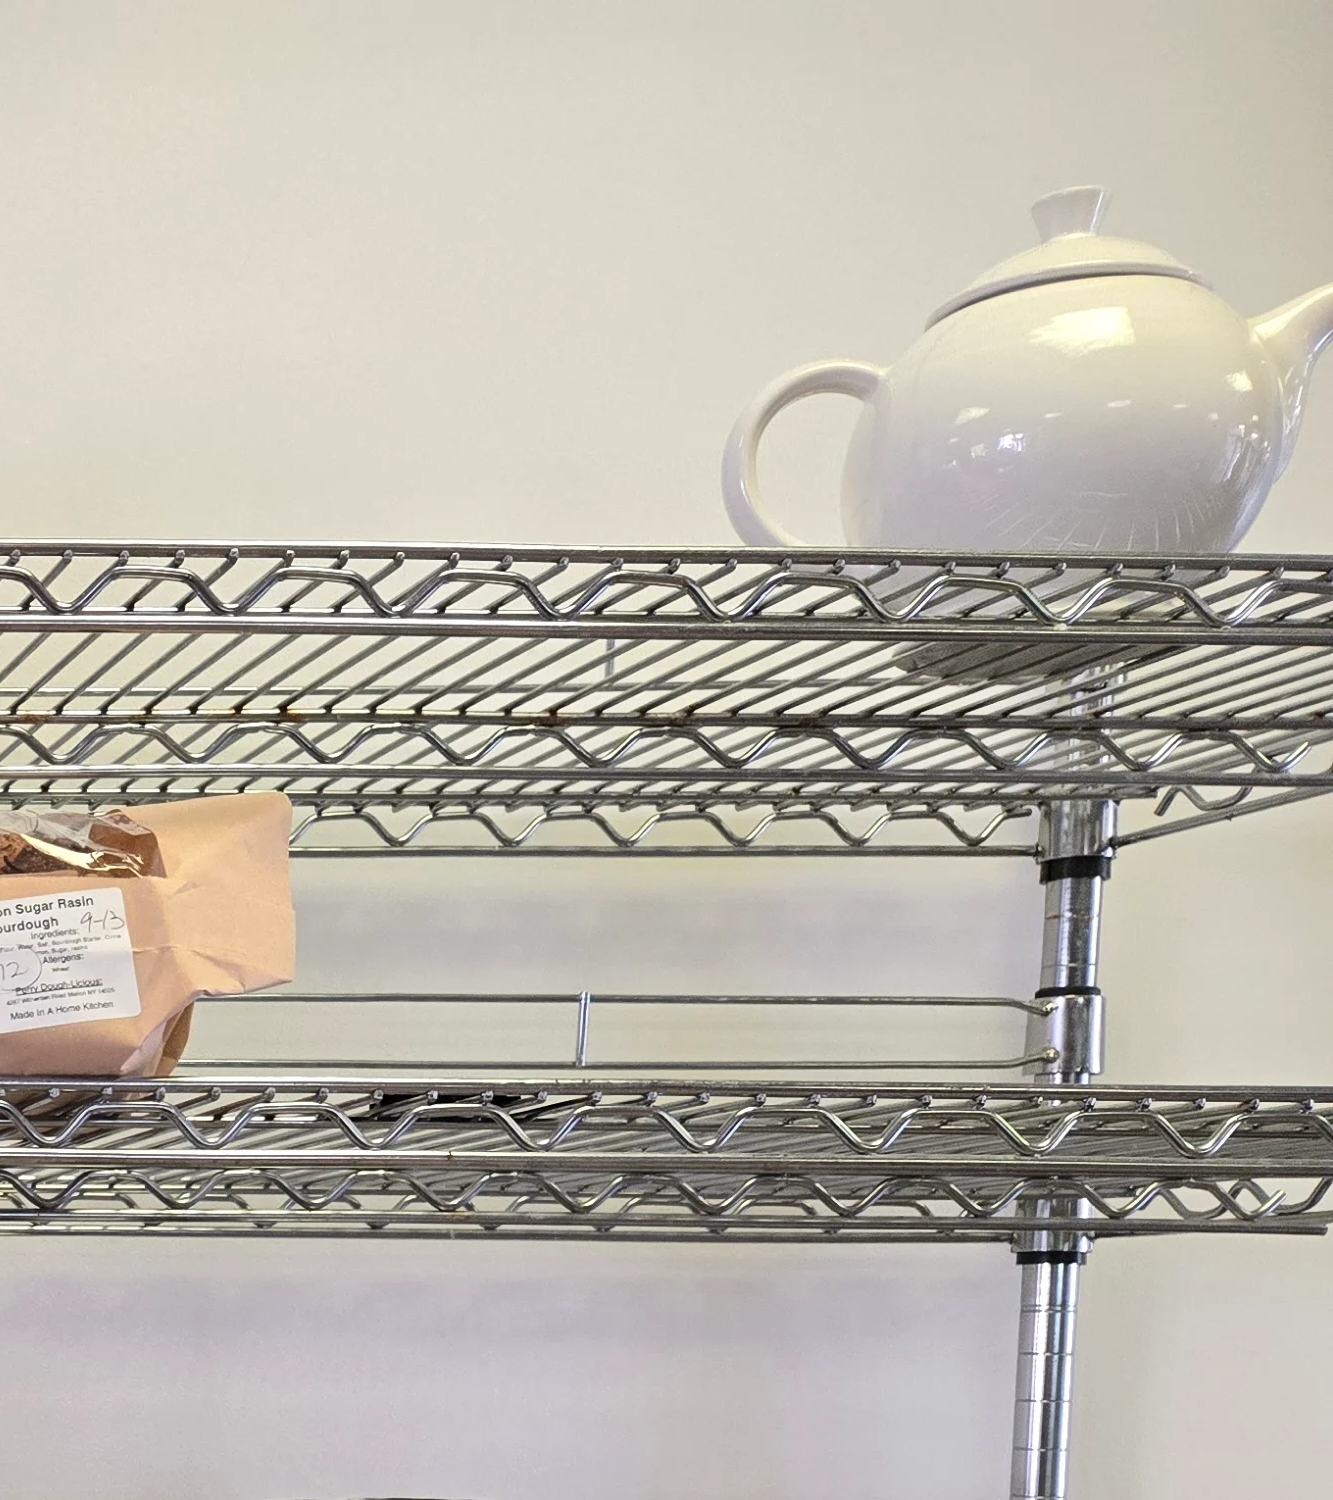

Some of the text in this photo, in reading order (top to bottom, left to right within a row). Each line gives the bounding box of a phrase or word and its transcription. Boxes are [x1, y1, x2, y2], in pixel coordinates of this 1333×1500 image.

[15, 901, 53, 916] Sugar
[57, 896, 94, 910] Rasin
[10, 1010, 35, 1021] Made
[56, 1005, 81, 1015] Home
[83, 1000, 114, 1012] Kitchen
